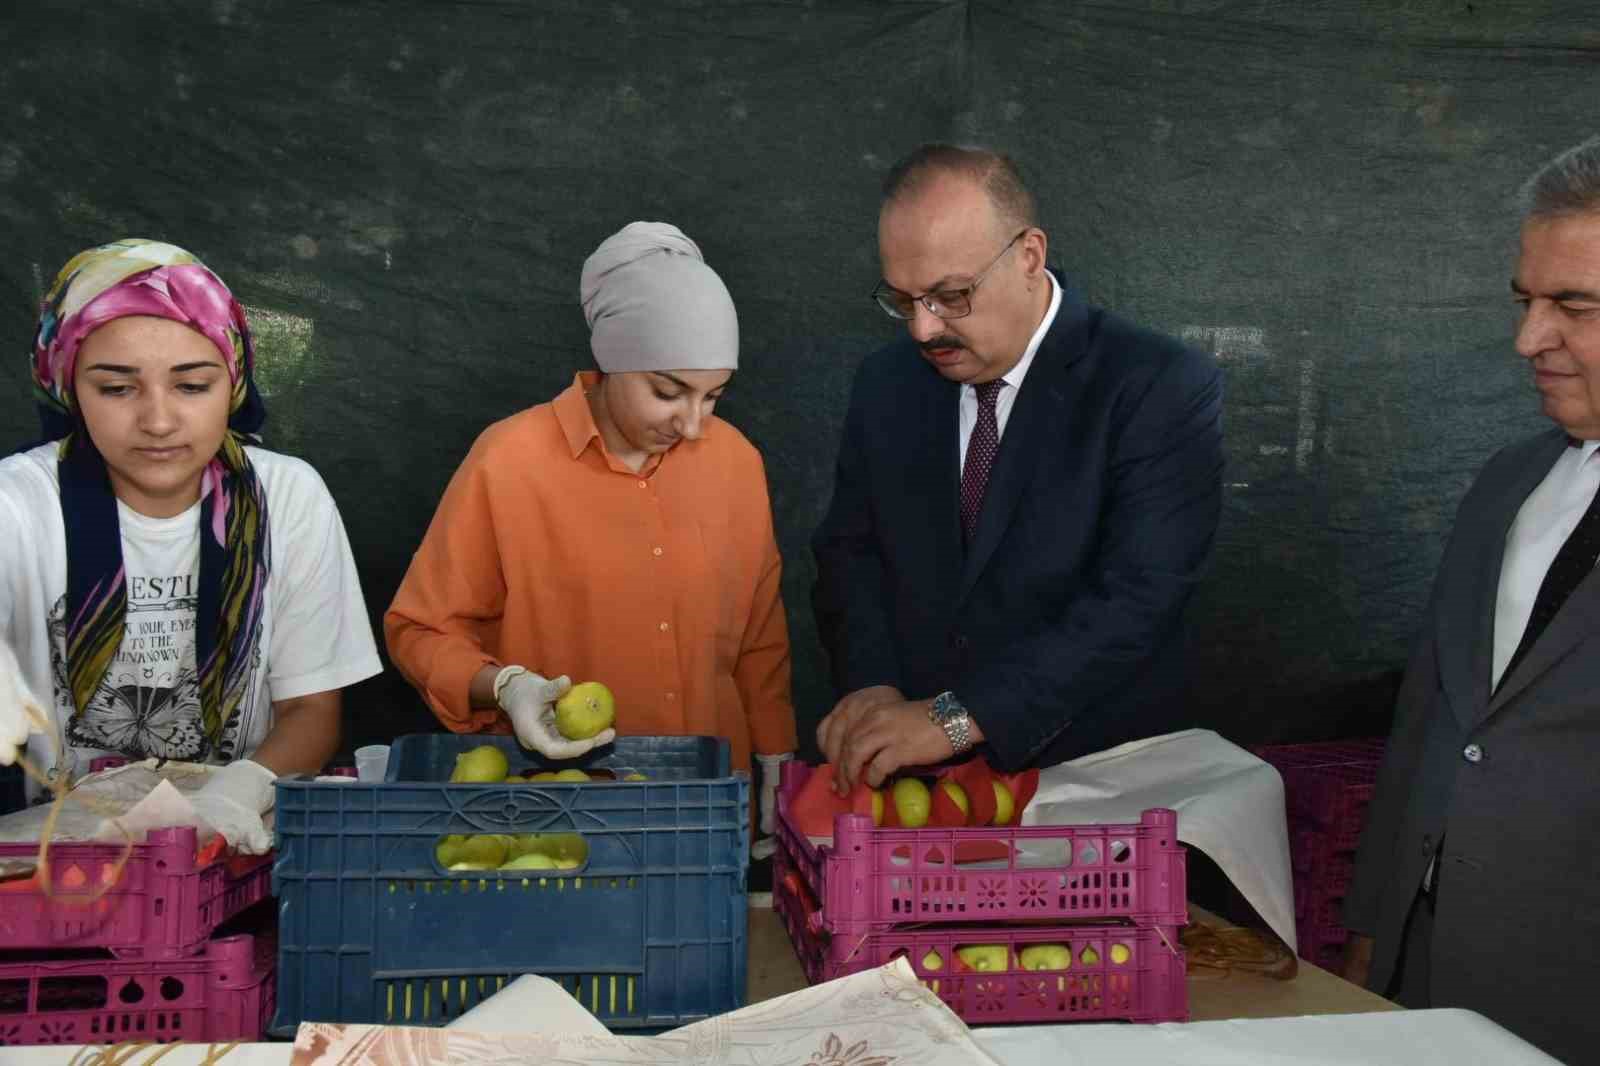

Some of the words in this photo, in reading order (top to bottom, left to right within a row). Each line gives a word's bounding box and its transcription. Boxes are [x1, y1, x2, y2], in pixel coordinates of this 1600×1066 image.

[131, 575, 192, 599] ESTI
[131, 637, 145, 650] TO
[150, 634, 174, 648] THE
